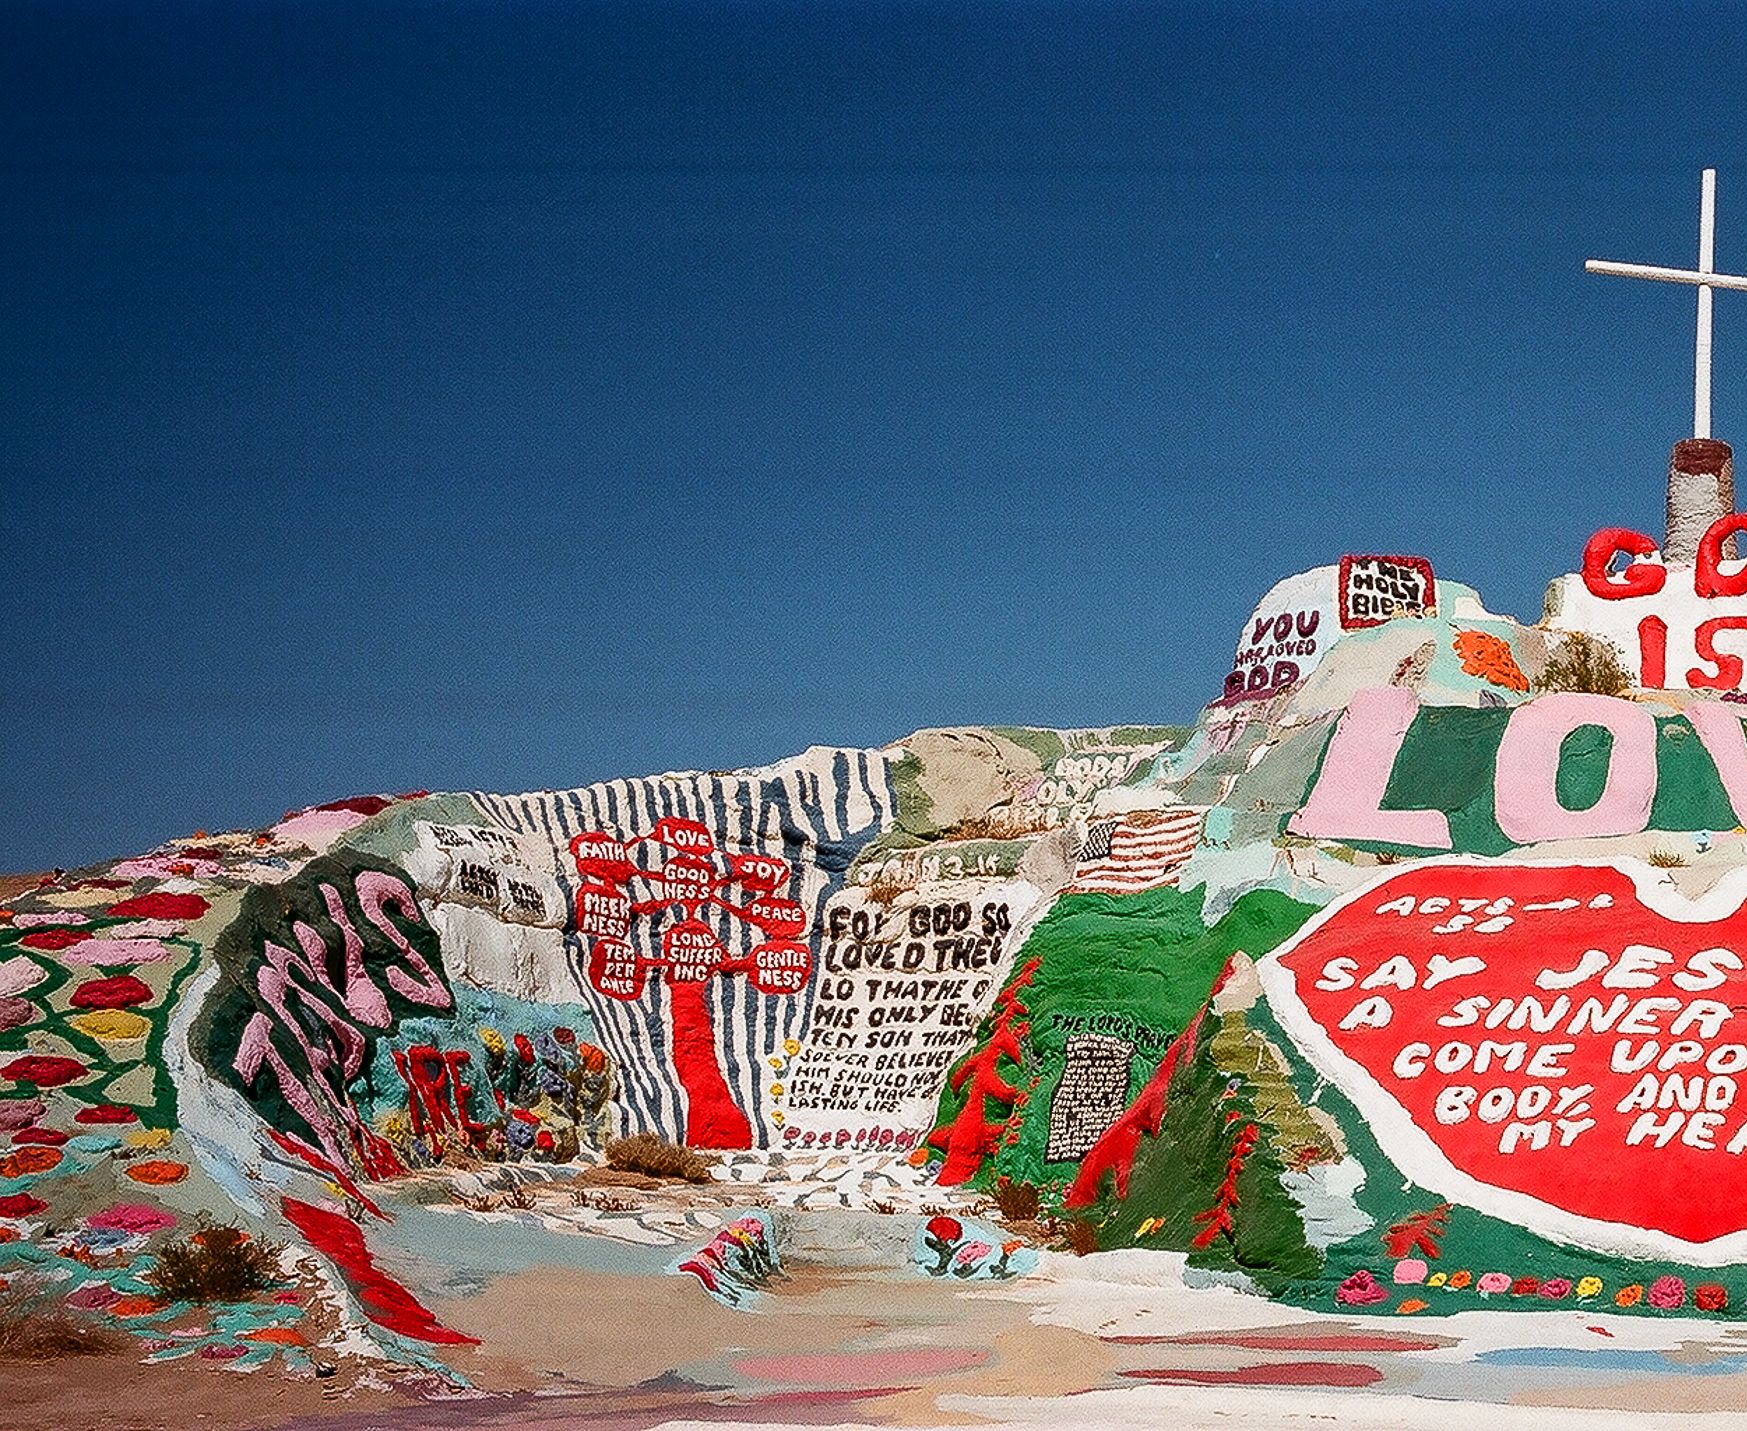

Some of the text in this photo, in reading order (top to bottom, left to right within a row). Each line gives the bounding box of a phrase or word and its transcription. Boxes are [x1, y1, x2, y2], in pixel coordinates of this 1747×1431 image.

[1356, 559, 1416, 582] THE
[1353, 574, 1420, 601] HOLY
[1252, 611, 1319, 645] YOU
[1225, 661, 1300, 695] GOD
[662, 825, 710, 847] LOVE
[579, 841, 626, 861] FAITH
[664, 863, 709, 884] GOOD
[741, 861, 786, 886] JOY
[664, 882, 711, 900] NESS
[584, 892, 632, 919] MEEK
[752, 903, 804, 922] PEACE
[1376, 895, 1516, 917] ACTS
[584, 913, 626, 938] NESS
[908, 902, 973, 938] GOD
[982, 902, 1012, 937] SO
[671, 932, 716, 948] LONG
[604, 943, 636, 961] TEM
[667, 946, 722, 965] SUFFER
[756, 949, 807, 969] GENTLE
[826, 942, 926, 973] LOVED
[759, 968, 802, 990] NESS
[1314, 955, 1489, 992] SAY
[868, 1003, 939, 1028] ONLY
[1052, 1014, 1086, 1032] THE
[1338, 994, 1395, 1032] A
[1436, 992, 1737, 1041] SINNER
[811, 1028, 858, 1049] TEN
[865, 1030, 913, 1049] SON
[799, 1048, 870, 1068] SOEVER
[1392, 1038, 1578, 1080] COME
[795, 1066, 831, 1080] HIM
[834, 1069, 908, 1088] SHOULD
[830, 1083, 869, 1098] BUT
[874, 1086, 922, 1101] HAVE
[1614, 1072, 1739, 1114] AND
[788, 1096, 859, 1111] LASTING
[1498, 1116, 1598, 1155] MY
